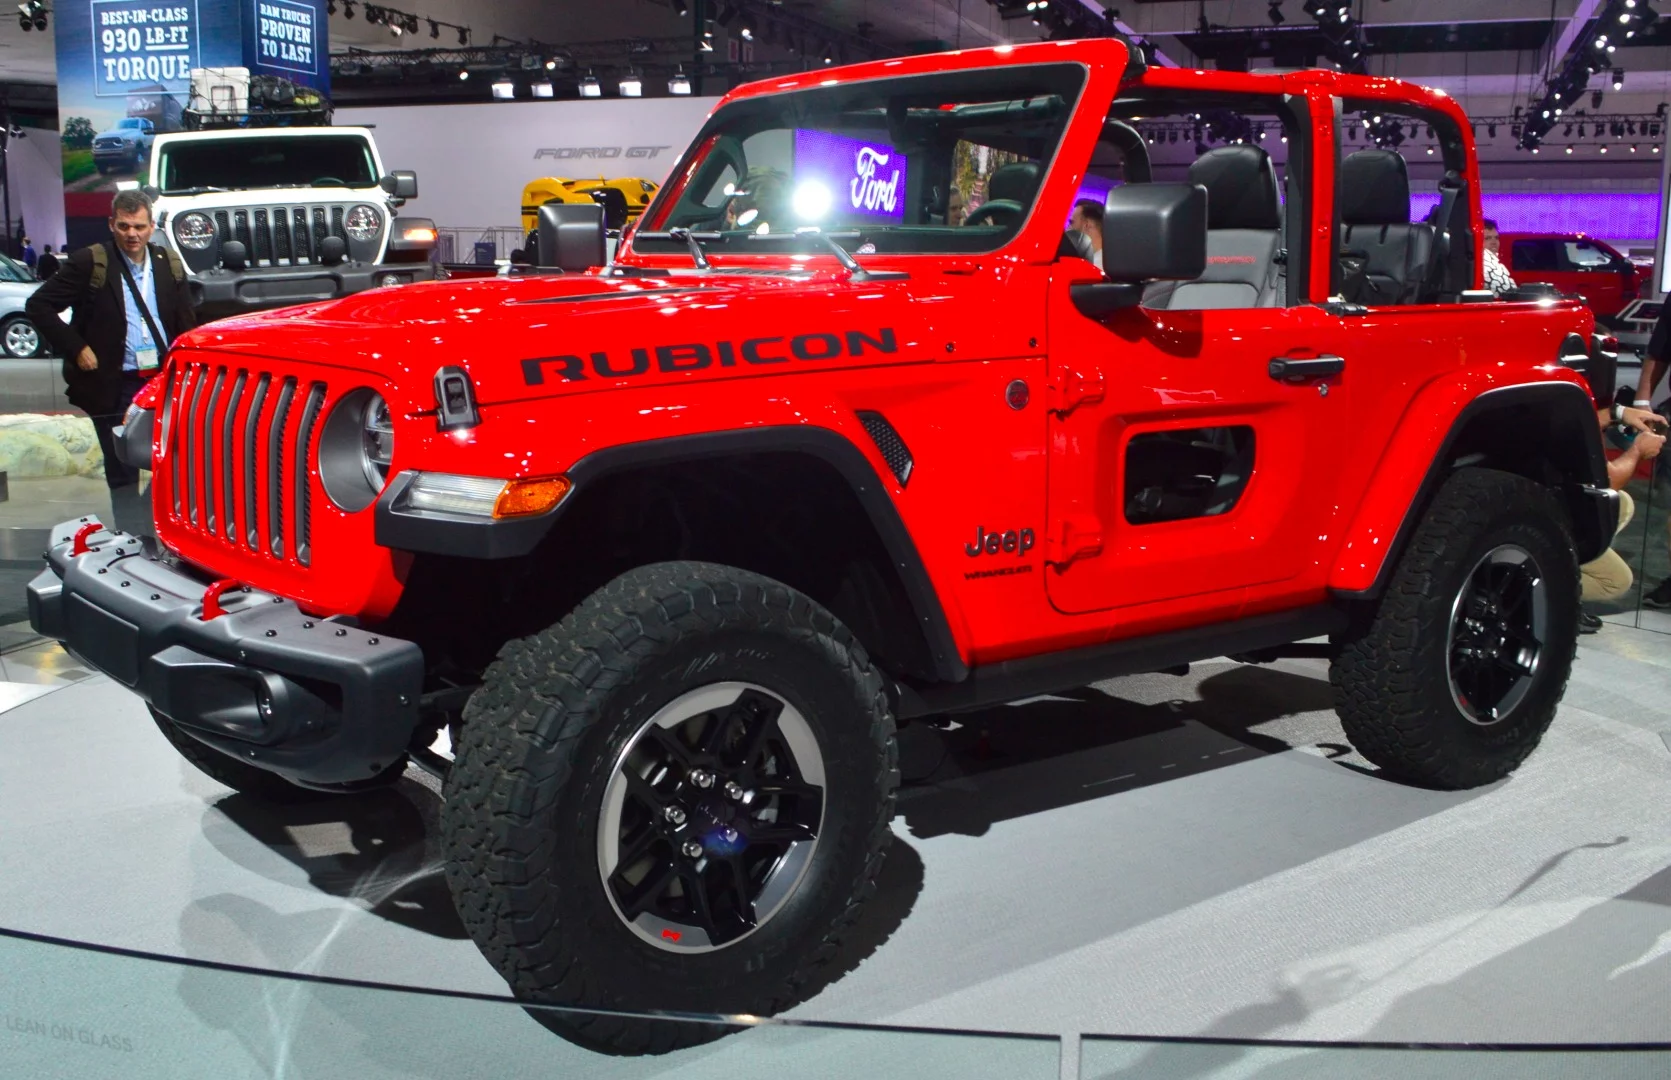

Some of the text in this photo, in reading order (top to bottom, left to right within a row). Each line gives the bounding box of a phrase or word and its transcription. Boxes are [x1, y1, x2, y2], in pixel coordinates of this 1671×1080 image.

[100, 7, 188, 25] BEST-IN-CLASS
[260, 3, 311, 25] RAM TRUCKS
[102, 26, 188, 53] 930 LB-FT
[260, 18, 311, 44] PROVEN
[261, 38, 311, 63] TO LAST
[103, 55, 190, 82] TORQUE
[533, 146, 672, 159] FORD GT
[850, 146, 900, 213] Ford
[520, 328, 898, 386] RUBICON
[964, 525, 1035, 557] Jeep
[6, 1015, 134, 1053] LEAN ON GLASS
